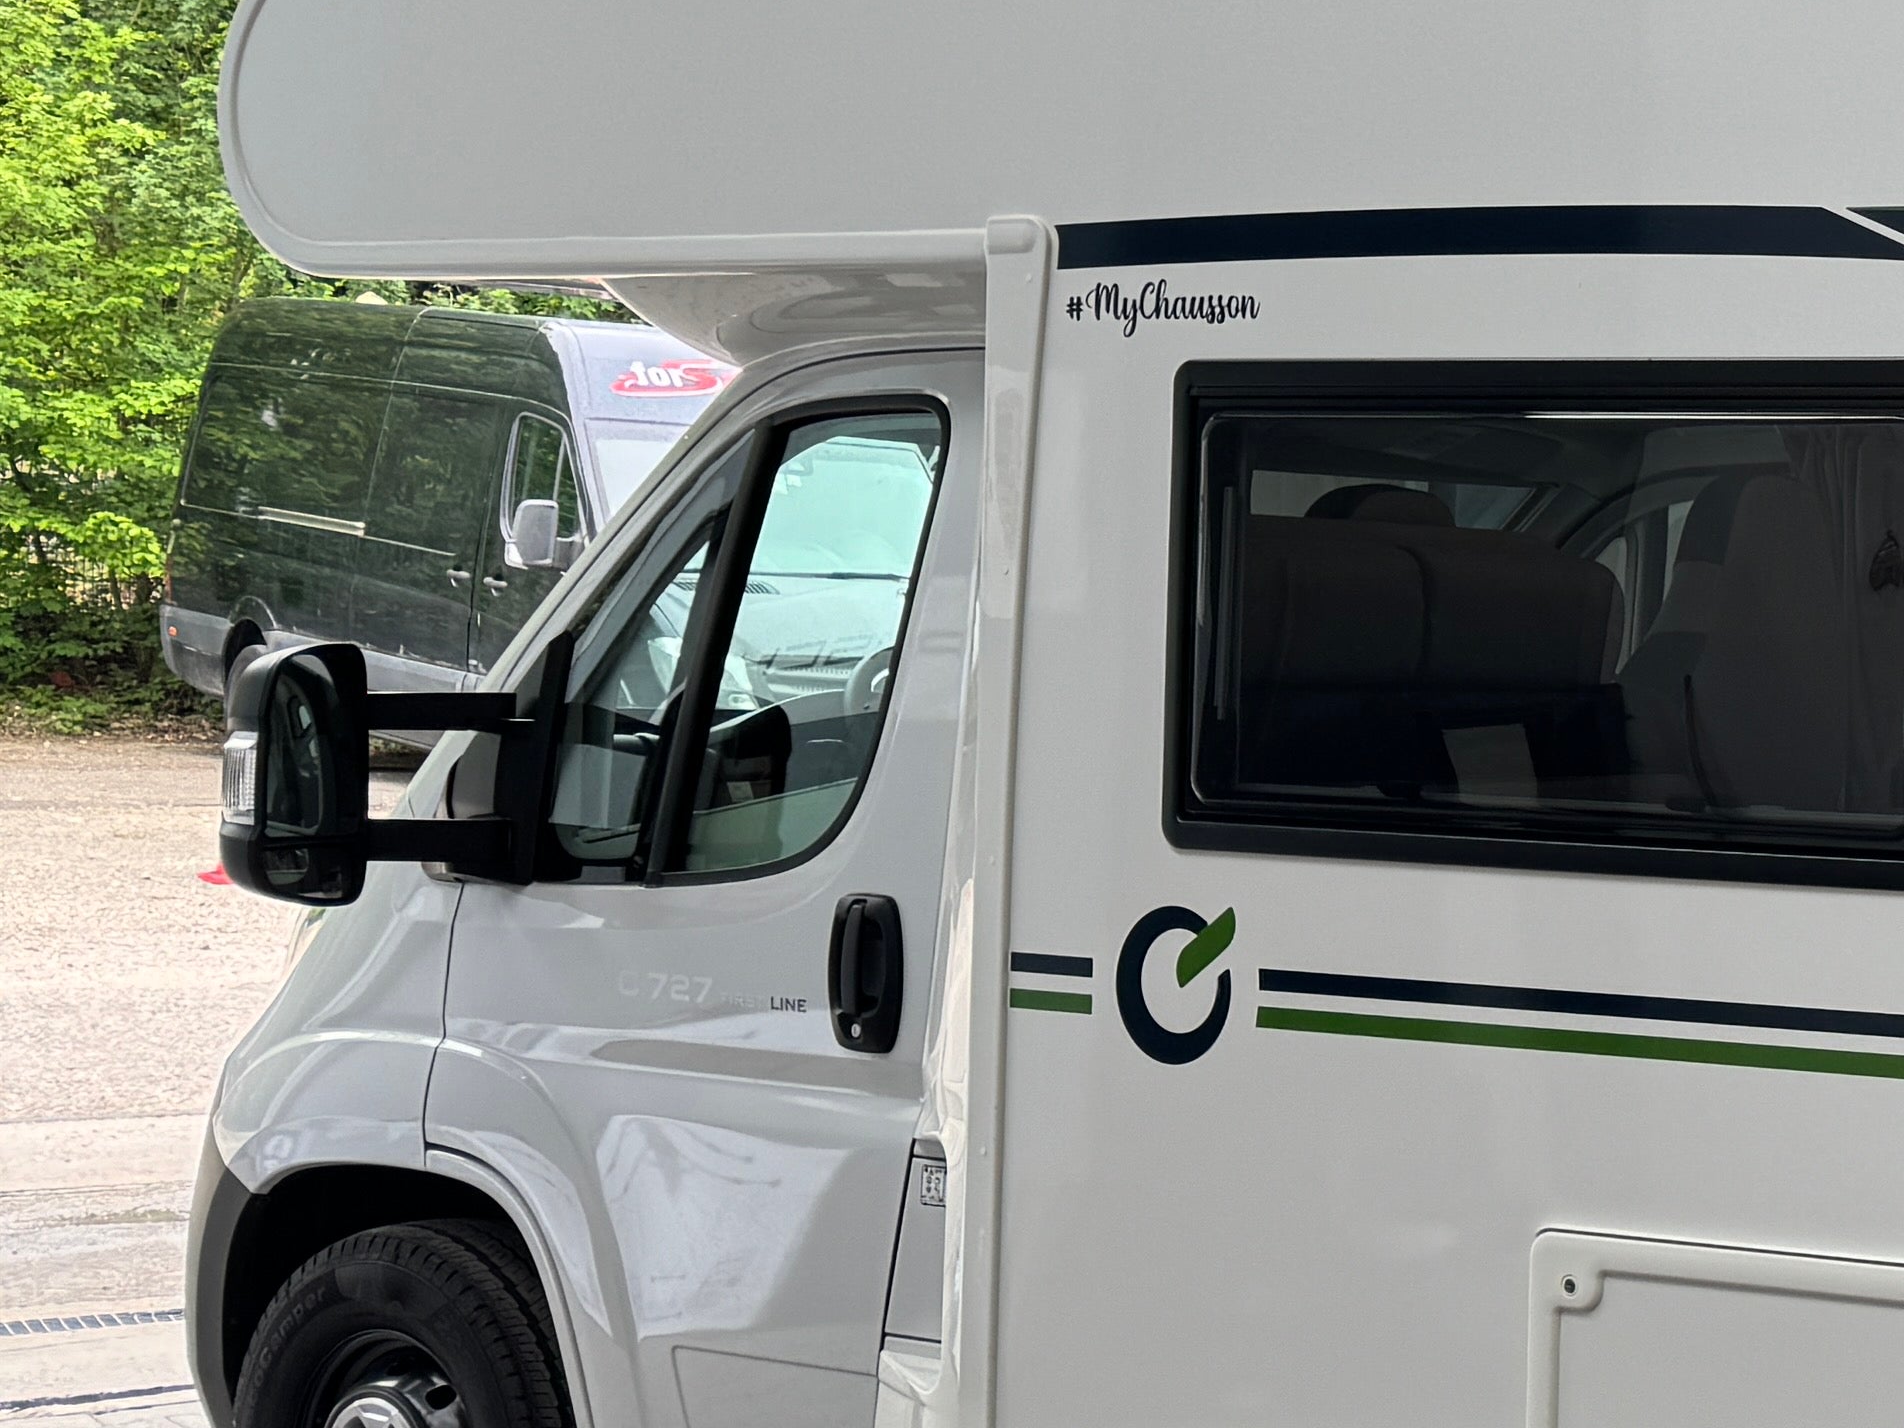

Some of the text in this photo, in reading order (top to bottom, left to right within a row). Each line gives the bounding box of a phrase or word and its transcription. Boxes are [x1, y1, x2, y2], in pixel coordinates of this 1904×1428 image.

[1065, 279, 1261, 337] #MyChausson
[648, 972, 713, 1003] 727
[770, 996, 807, 1013] LINE
